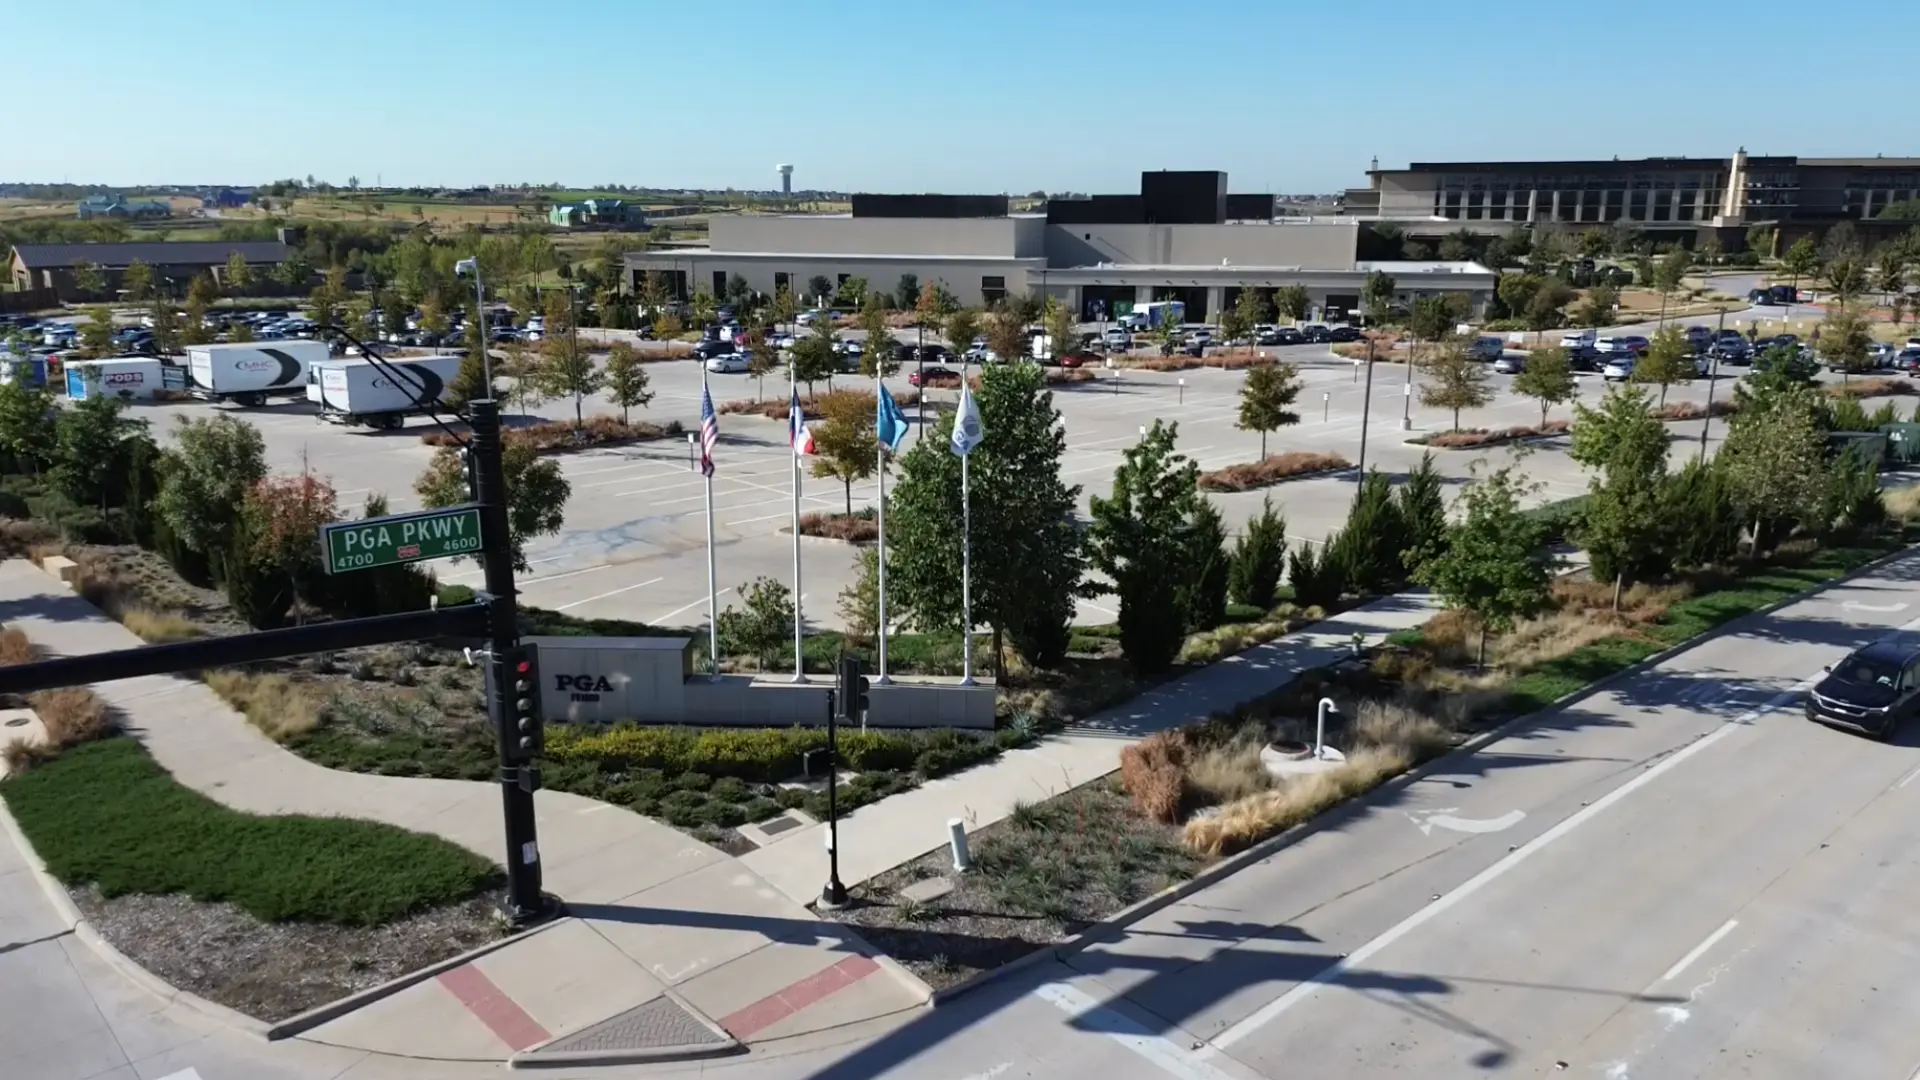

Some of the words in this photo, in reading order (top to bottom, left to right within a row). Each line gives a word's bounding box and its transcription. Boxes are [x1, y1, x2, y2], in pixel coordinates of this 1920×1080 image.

[105, 373, 142, 382] PODS
[344, 526, 393, 552] PGA
[402, 515, 466, 543] PKWY
[443, 537, 477, 551] 4600
[337, 552, 374, 567] 4700
[555, 674, 614, 692] PGA
